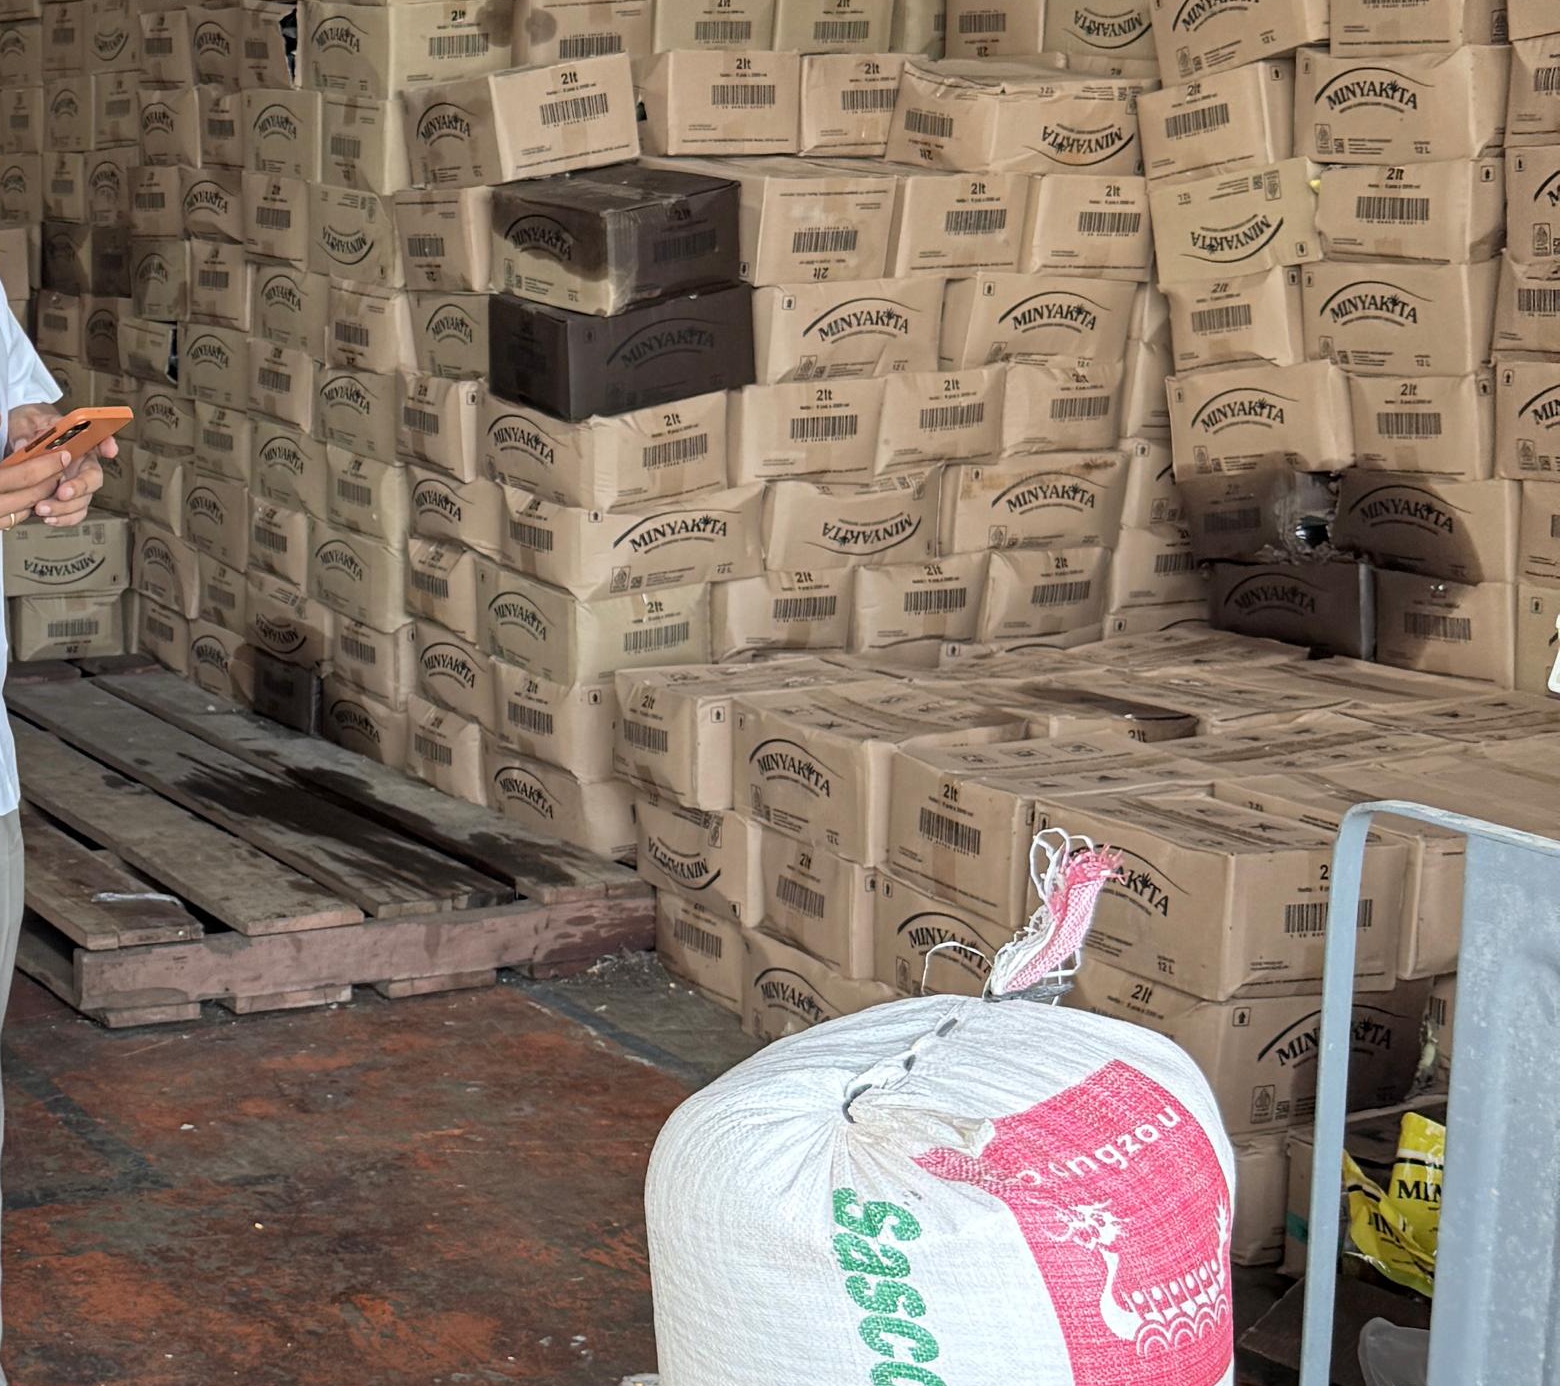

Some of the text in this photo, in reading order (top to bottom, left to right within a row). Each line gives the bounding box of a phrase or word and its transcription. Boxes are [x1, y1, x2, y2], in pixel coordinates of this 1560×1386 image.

[1074, 9, 1143, 38] MINYAKITA
[736, 58, 752, 71] 2lt
[864, 62, 880, 76] 2lt
[560, 71, 579, 85] 2lt
[1326, 80, 1419, 111] MINYAKITA
[1042, 124, 1125, 153] MINYAKITA
[1386, 167, 1404, 181] 2lt
[970, 182, 986, 196] 2lt
[1105, 184, 1121, 198] 2lt
[1190, 215, 1272, 252] MINYAKITA
[1011, 304, 1098, 332] MINYAKITA
[1330, 293, 1418, 325] MINYAKITA
[817, 310, 910, 343] MINYAKITA
[815, 388, 833, 402] 2lt
[944, 378, 961, 392] 2lt
[1399, 382, 1418, 397] 2lt
[663, 413, 681, 427] 2lt
[1200, 399, 1285, 434] MINYAKITA
[492, 426, 555, 465] MINYAKITA
[1005, 483, 1096, 514] MINYAKITA
[1359, 498, 1455, 535] MINYAKITA
[628, 515, 728, 554] MINYAKITA
[822, 513, 913, 546] MINYAKITA
[795, 570, 814, 584] 2lt
[924, 565, 942, 577] 2lt
[646, 600, 663, 614] 2lt
[757, 753, 832, 799] MINYAKITA
[943, 783, 959, 802] 2lt
[1130, 984, 1153, 1004] 2lt
